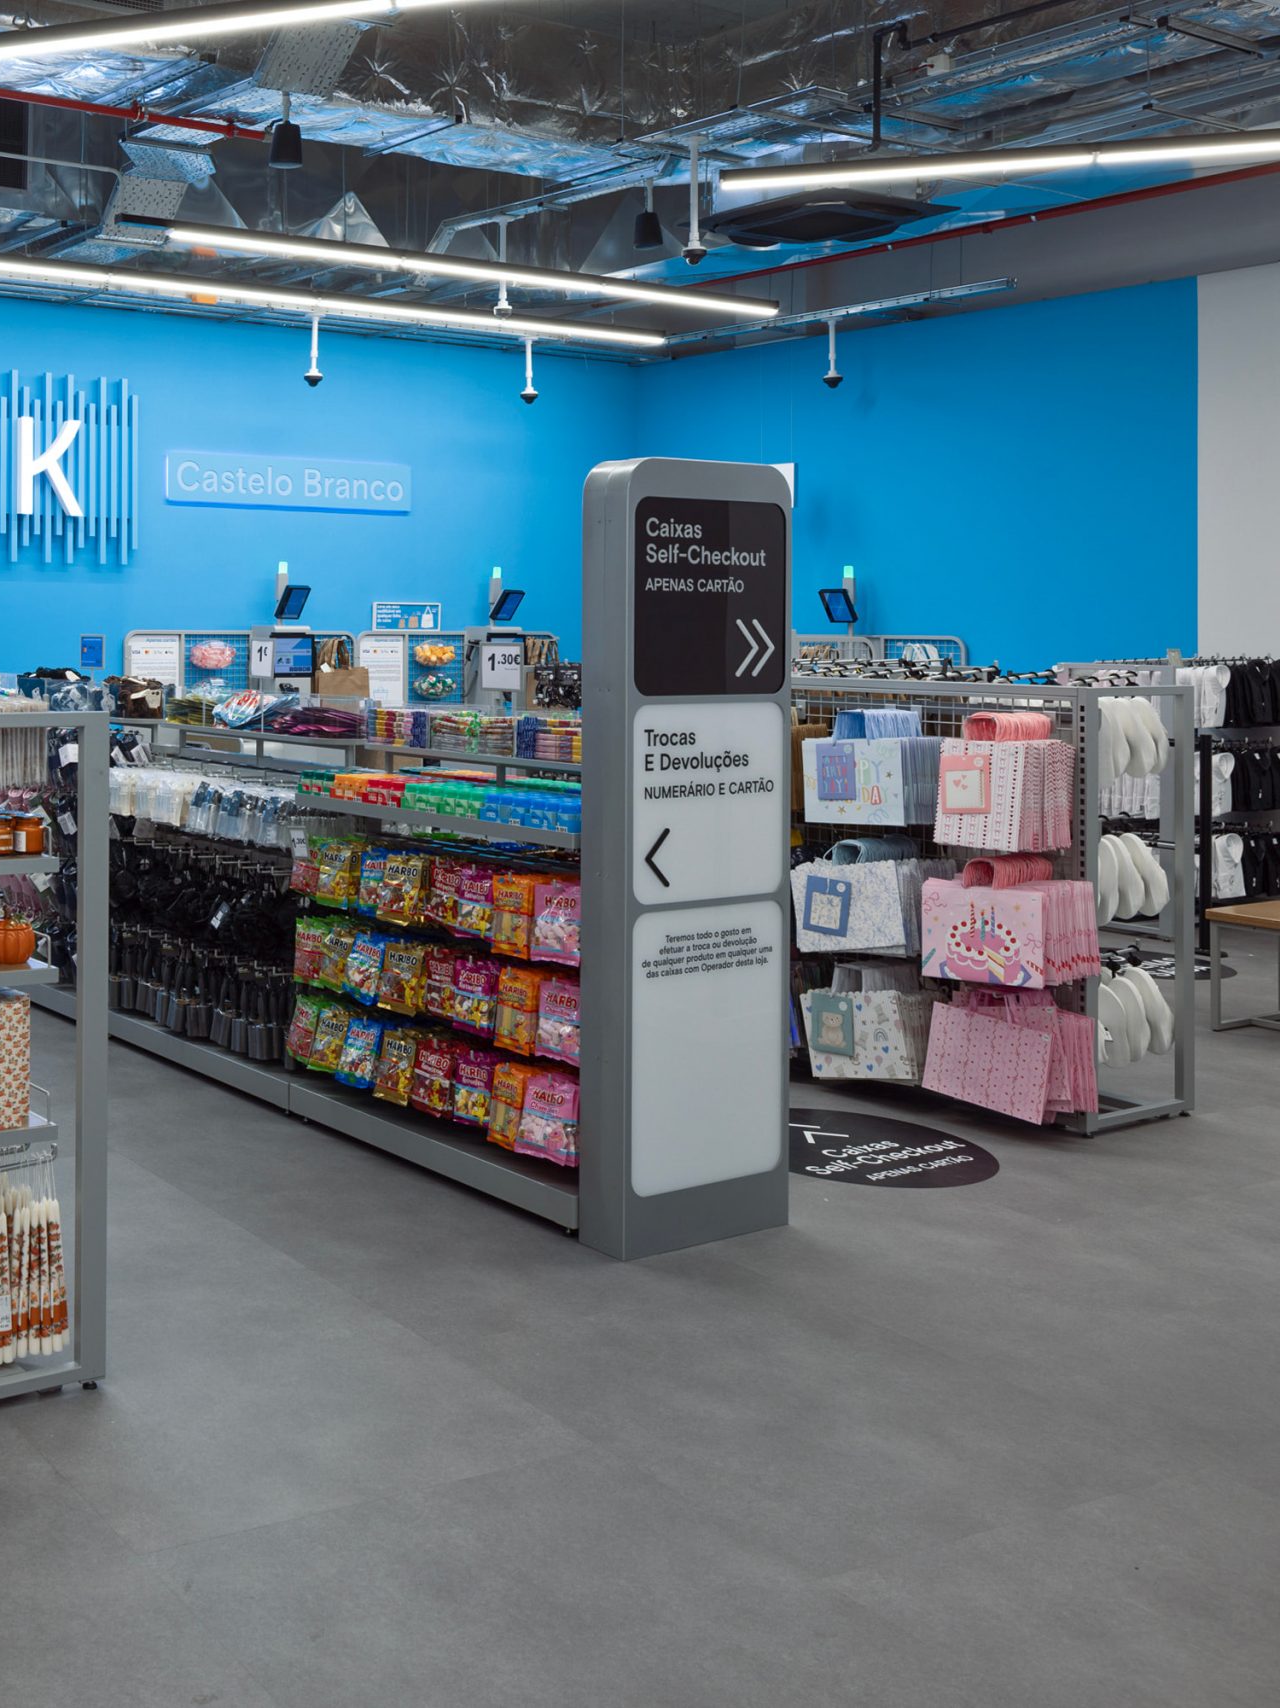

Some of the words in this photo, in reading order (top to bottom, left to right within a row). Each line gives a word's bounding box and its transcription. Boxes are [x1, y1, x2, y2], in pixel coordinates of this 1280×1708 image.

[176, 460, 293, 497] Castelo
[303, 468, 404, 502] Branco
[645, 517, 702, 539] Caixas
[646, 543, 766, 567] Self-Checkout
[645, 577, 694, 592] APENAS
[697, 577, 744, 593] CARTÃO
[487, 653, 521, 671] 1.30€
[644, 729, 696, 747] Trocas
[644, 754, 654, 772] E
[660, 751, 749, 773] Devoluções
[644, 780, 715, 800] NUMERÁRIO
[719, 783, 725, 796] E
[729, 778, 774, 795] CARTÃO
[545, 895, 576, 908] HRIBO
[659, 944, 685, 955] efetuar
[692, 942, 710, 951] troca
[722, 936, 757, 951] devolução
[665, 932, 695, 944] Teremos
[696, 930, 712, 941] todo
[720, 928, 740, 940] gosto
[741, 927, 752, 935] em
[641, 959, 651, 968] de
[653, 954, 685, 969] qualquer
[686, 951, 714, 966] produto
[715, 951, 726, 959] em
[727, 946, 758, 960] qualquer
[759, 946, 773, 954] uma
[646, 969, 660, 979] das
[661, 967, 682, 978] caixas
[684, 966, 699, 974] com
[701, 961, 734, 975] Operador
[735, 958, 754, 968] desta
[805, 1140, 966, 1176] Self-Checkout
[822, 1140, 900, 1158] Caixas
[866, 1165, 922, 1181] APENAS
[919, 1155, 974, 1170] CARTÃO
